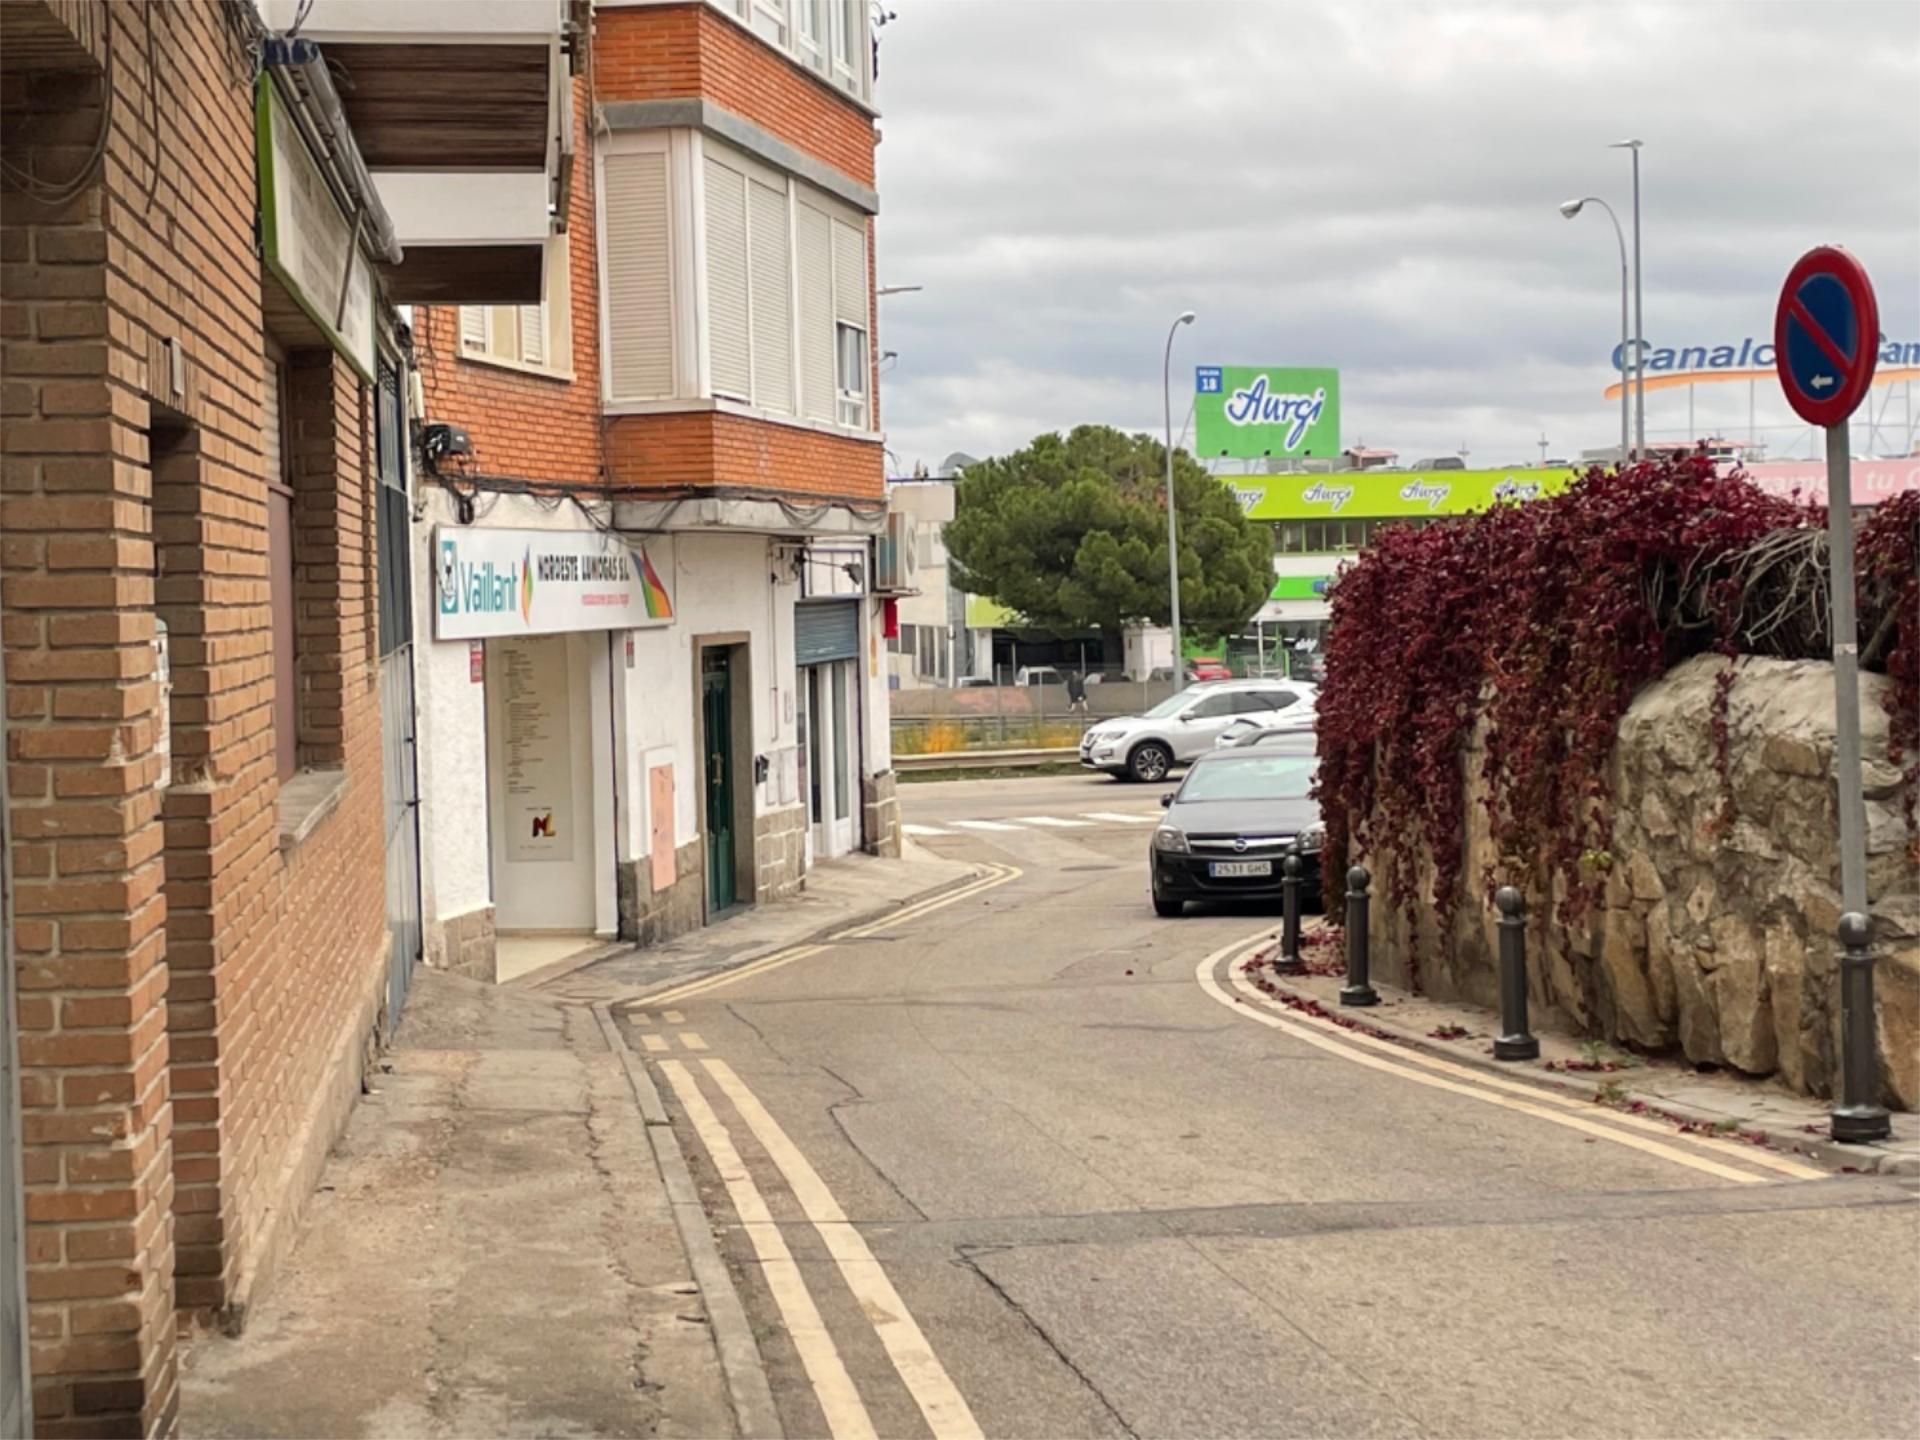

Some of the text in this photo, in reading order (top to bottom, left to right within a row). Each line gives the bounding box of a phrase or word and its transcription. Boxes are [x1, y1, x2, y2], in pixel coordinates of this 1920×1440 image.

[1202, 378, 1217, 391] 18
[1226, 377, 1325, 450] Aurgi
[1303, 480, 1353, 512] Aurgi
[1401, 478, 1450, 510] Aurgi
[1866, 469, 1896, 491] tu
[537, 554, 579, 582] NOROESTE
[460, 561, 517, 613] Vaillant
